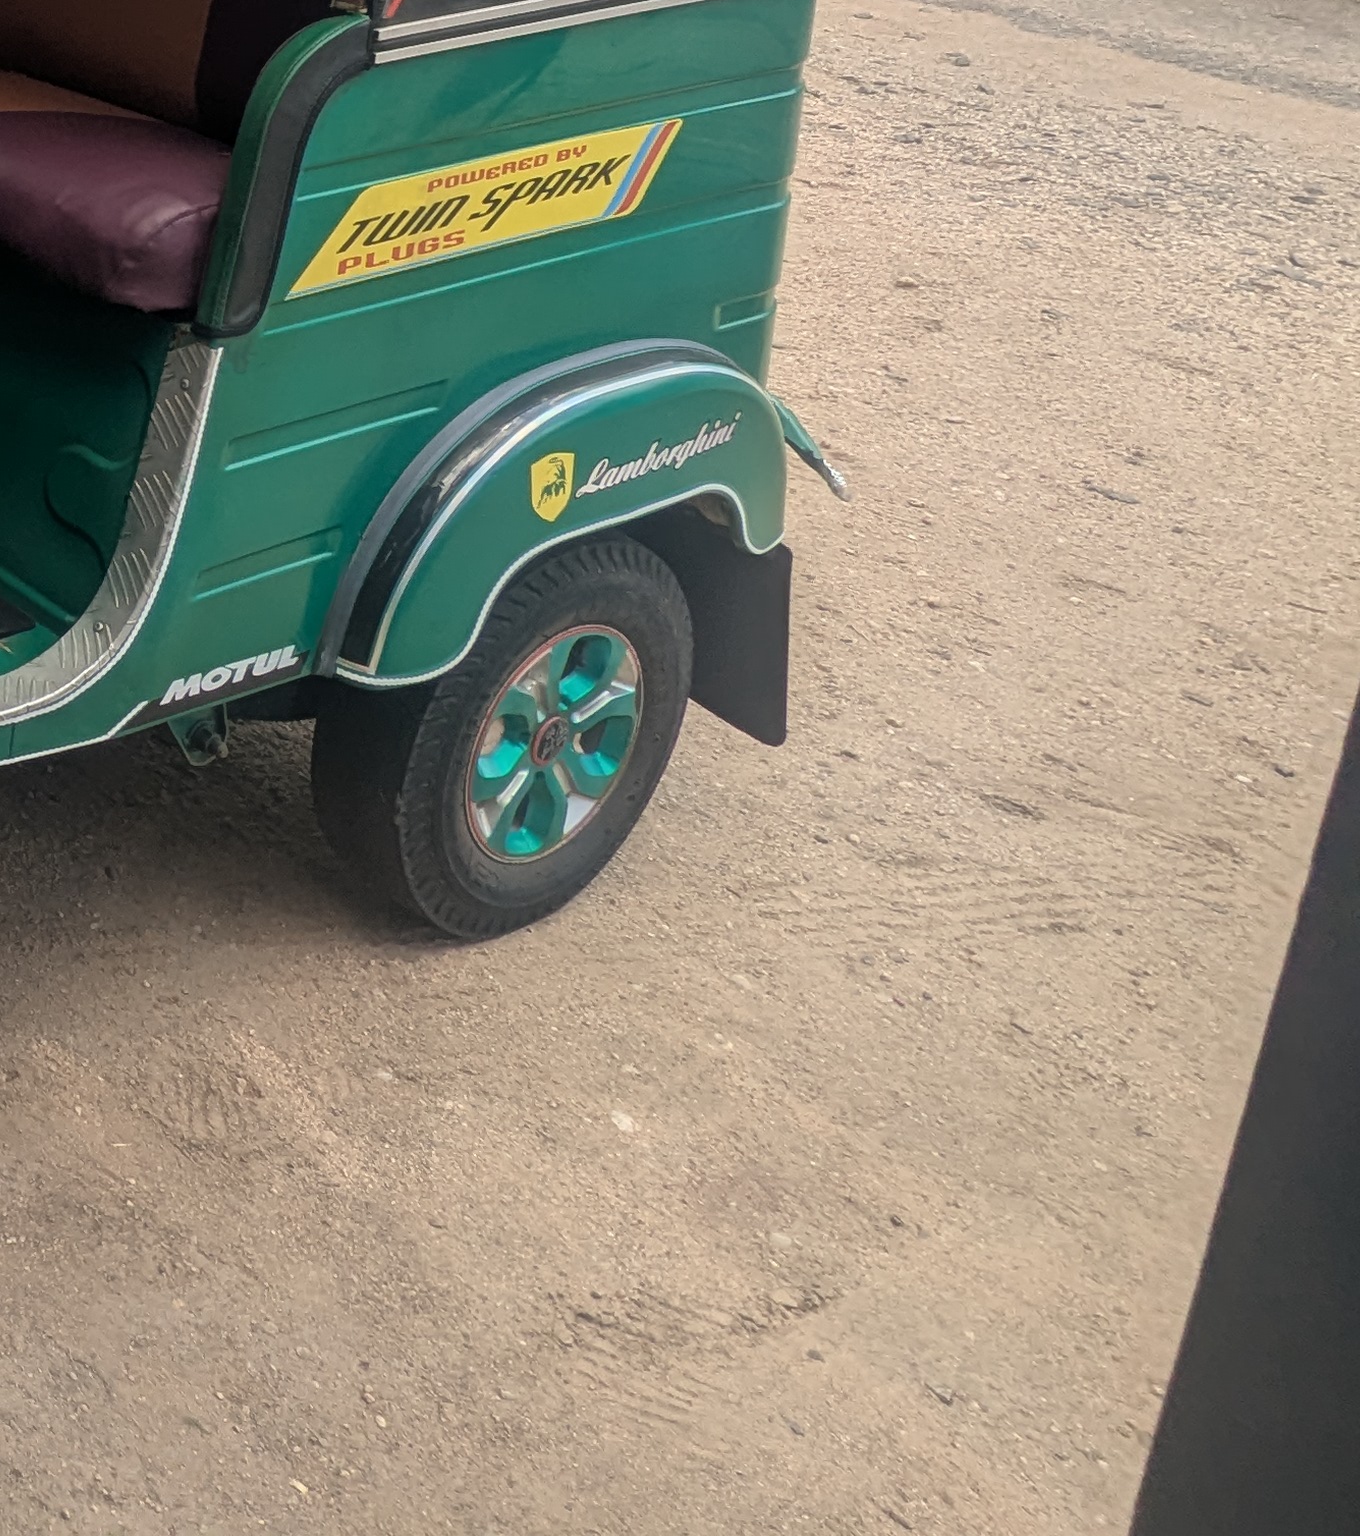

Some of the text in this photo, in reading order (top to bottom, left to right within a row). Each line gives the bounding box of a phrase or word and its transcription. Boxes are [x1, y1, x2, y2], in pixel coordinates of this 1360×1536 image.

[426, 144, 588, 193] POWERED BY
[336, 153, 632, 255] TWIN SPARK
[337, 229, 466, 276] PLUGS
[574, 411, 743, 498] Lamborghini
[159, 643, 300, 707] MOTUL
